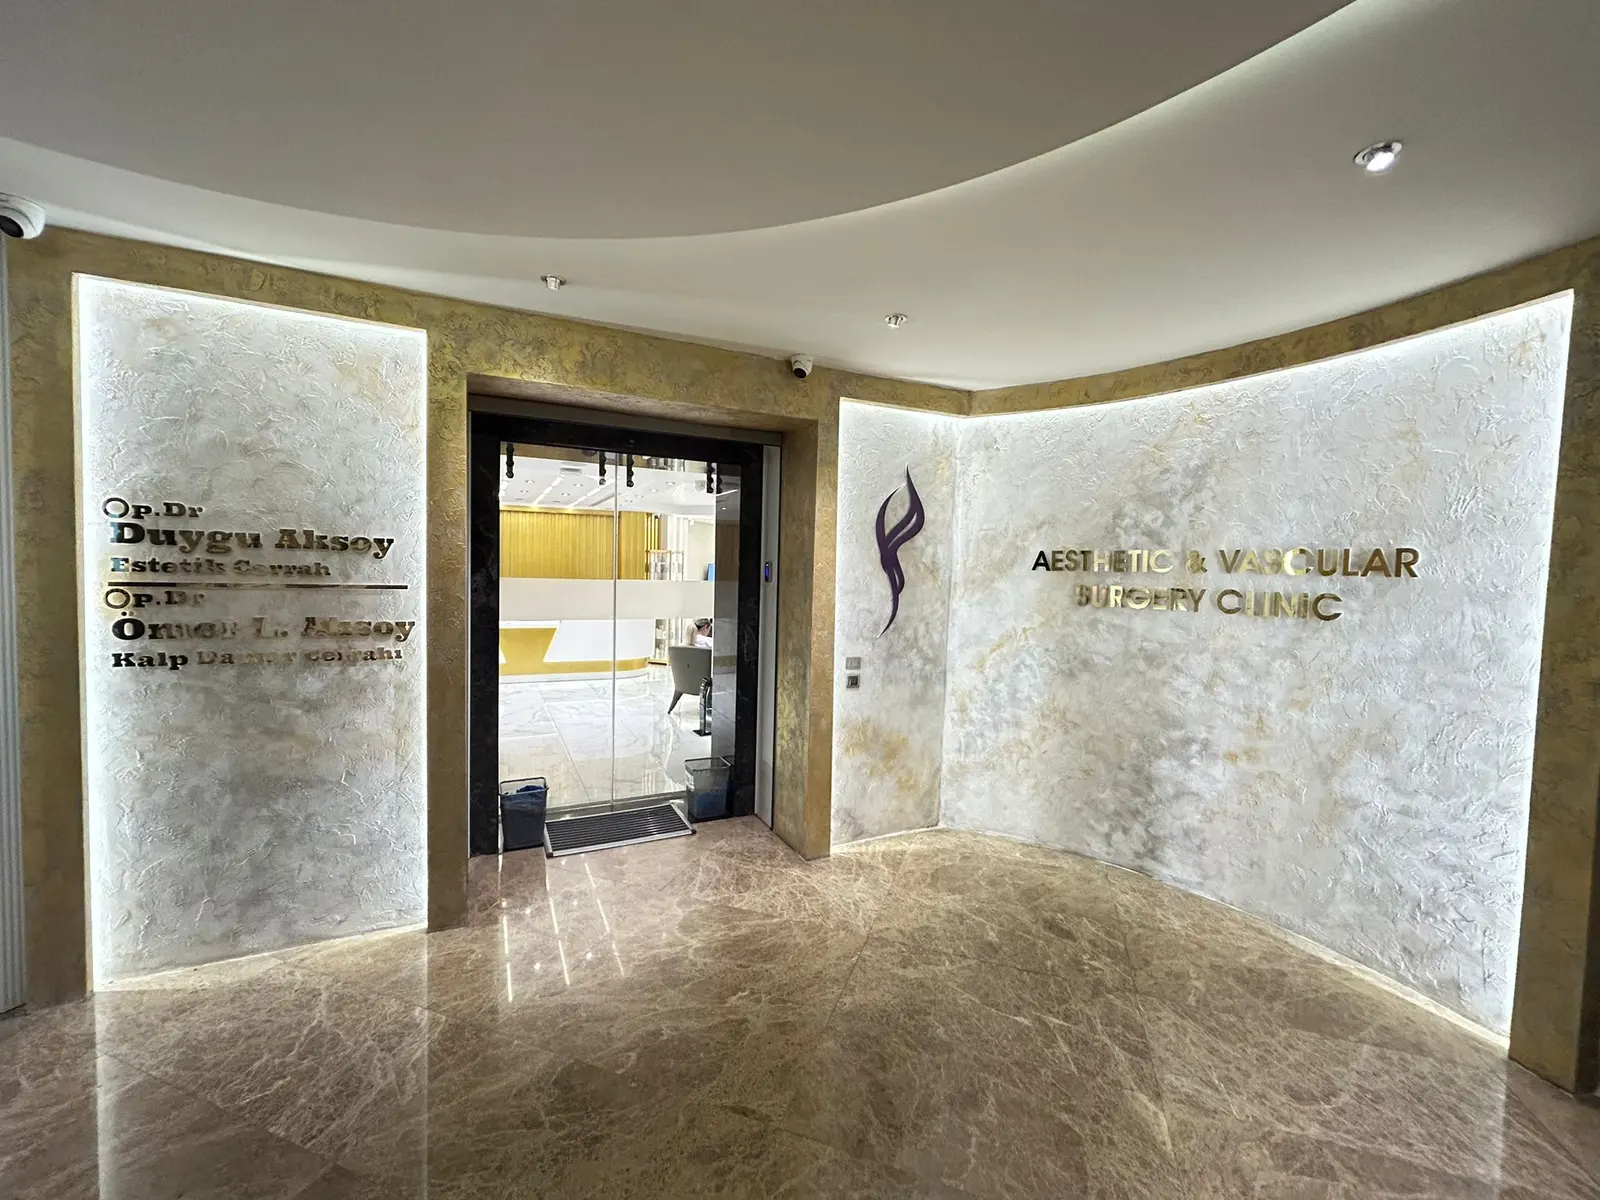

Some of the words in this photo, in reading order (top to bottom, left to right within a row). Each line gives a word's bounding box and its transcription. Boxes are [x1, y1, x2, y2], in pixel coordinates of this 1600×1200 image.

[102, 497, 203, 519] Op.Dr
[110, 522, 261, 554] Duygu
[275, 529, 394, 559] Aksoy
[110, 557, 226, 573] Estetik
[1032, 550, 1174, 573] AESTHETIC
[1186, 550, 1207, 573] &
[1219, 547, 1419, 577] VASCULAR
[105, 588, 204, 609] Op.Dr
[1075, 584, 1206, 612] SURGERY
[1216, 588, 1343, 621] CLINIC
[112, 611, 237, 640] Ömer
[301, 616, 415, 642] Aksoy
[111, 652, 188, 670] Kalp
